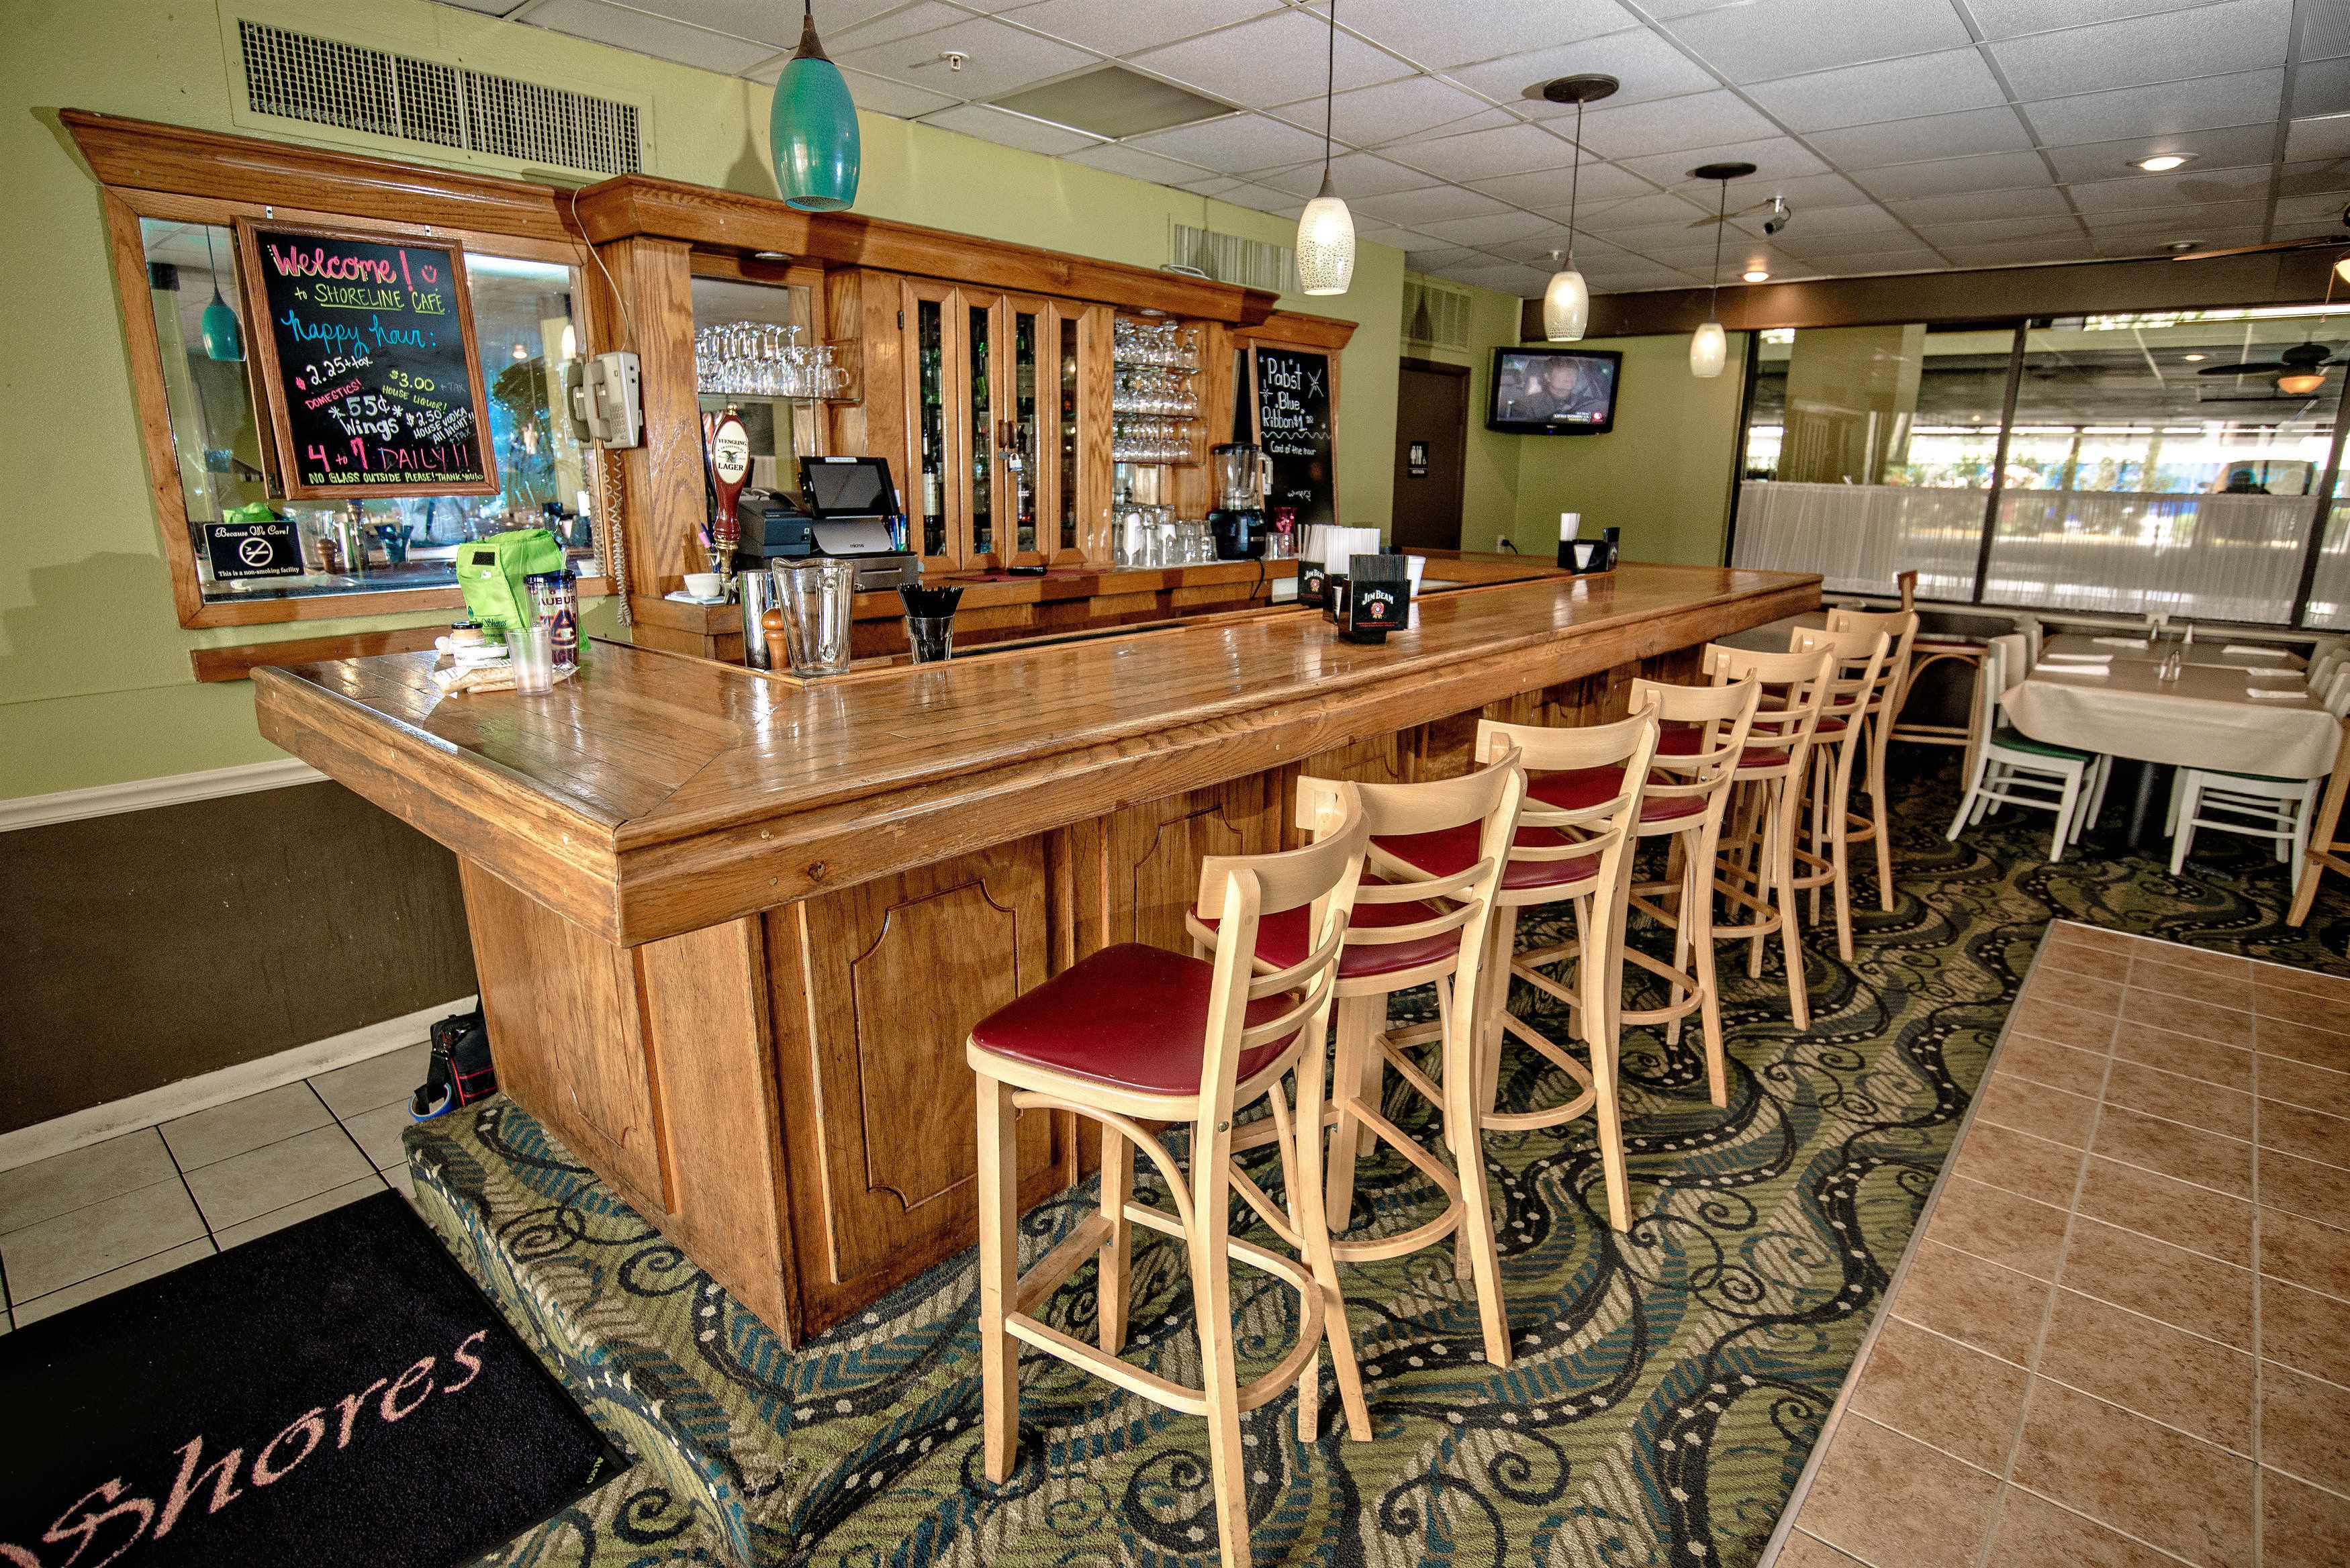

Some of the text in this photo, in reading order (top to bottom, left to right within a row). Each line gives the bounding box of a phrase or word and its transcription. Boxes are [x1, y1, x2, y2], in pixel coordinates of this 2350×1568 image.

[295, 287, 308, 300] to
[314, 283, 405, 308] SHORELINE
[281, 309, 370, 358] happy
[1267, 358, 1303, 390] Pabst
[305, 378, 362, 410] DOMESTICS!
[382, 385, 410, 400] HOUSE
[1278, 391, 1300, 410] Blue
[413, 407, 468, 440] HOUSE VODKA
[1262, 406, 1294, 428] Ribbon
[339, 418, 399, 442] Wings
[718, 438, 747, 446] YUENGLING
[1284, 444, 1291, 454] of
[1292, 445, 1303, 455] the
[308, 444, 330, 473] 4
[336, 454, 348, 464] to
[350, 437, 368, 470] 7
[718, 462, 743, 471] LAGER
[308, 473, 324, 484] NO
[329, 473, 361, 483] GLASS
[363, 473, 401, 483] OUTSIDE
[405, 473, 436, 483] PLEASE!
[437, 473, 461, 481] THANK
[215, 525, 289, 538] Because We Care!
[538, 595, 576, 605] AUBUR
[1362, 589, 1394, 605] JIM BEAM
